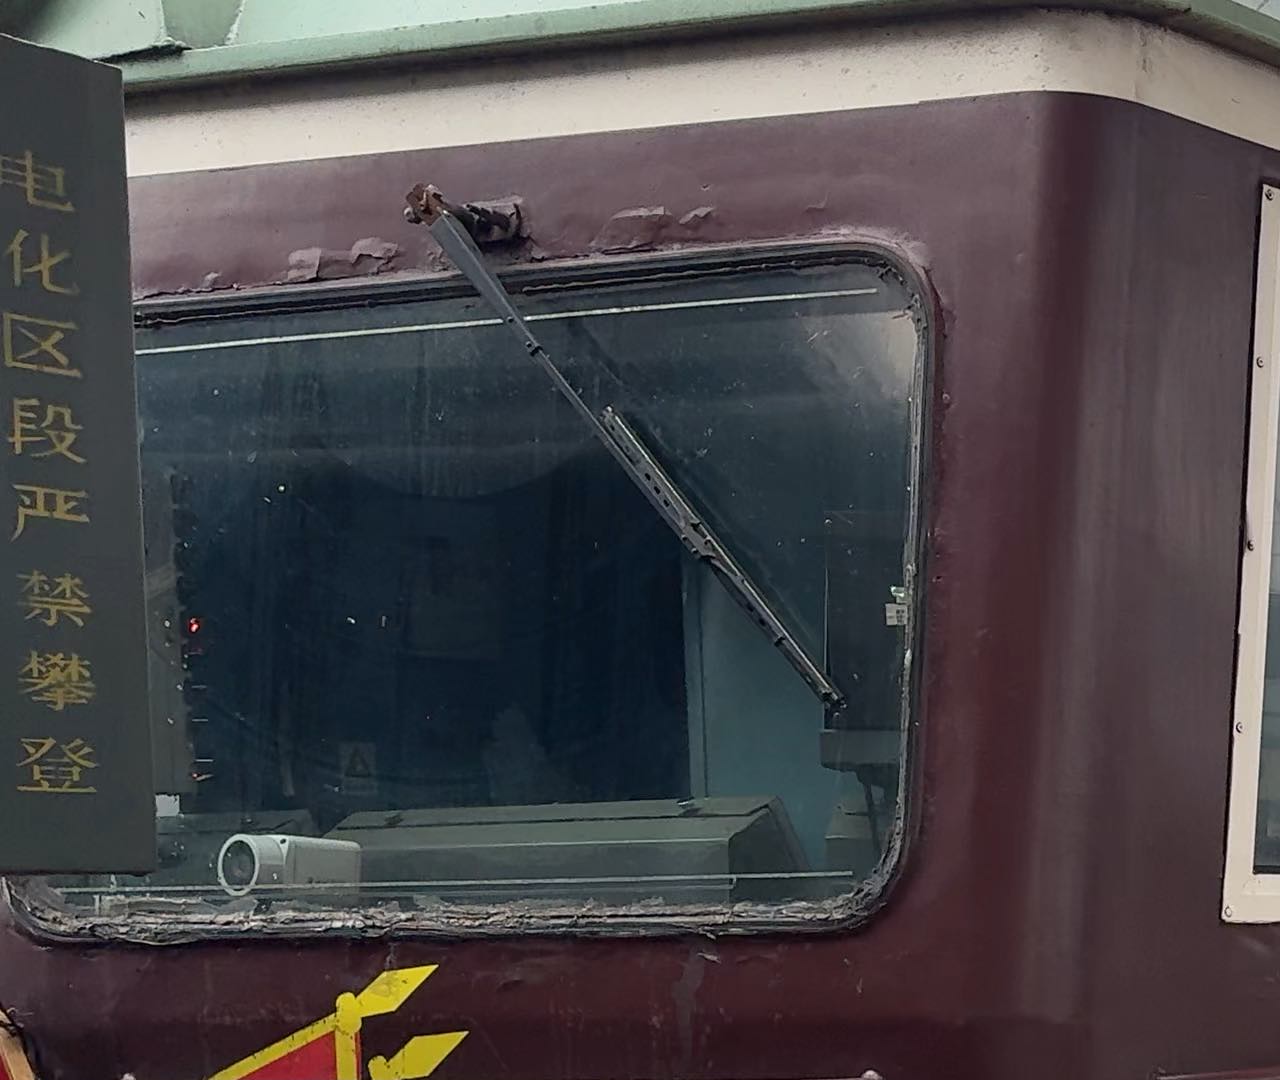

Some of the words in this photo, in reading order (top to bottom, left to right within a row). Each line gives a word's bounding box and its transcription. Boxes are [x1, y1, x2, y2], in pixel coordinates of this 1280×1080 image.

[0, 148, 98, 795] 电化区段严禁攀登
